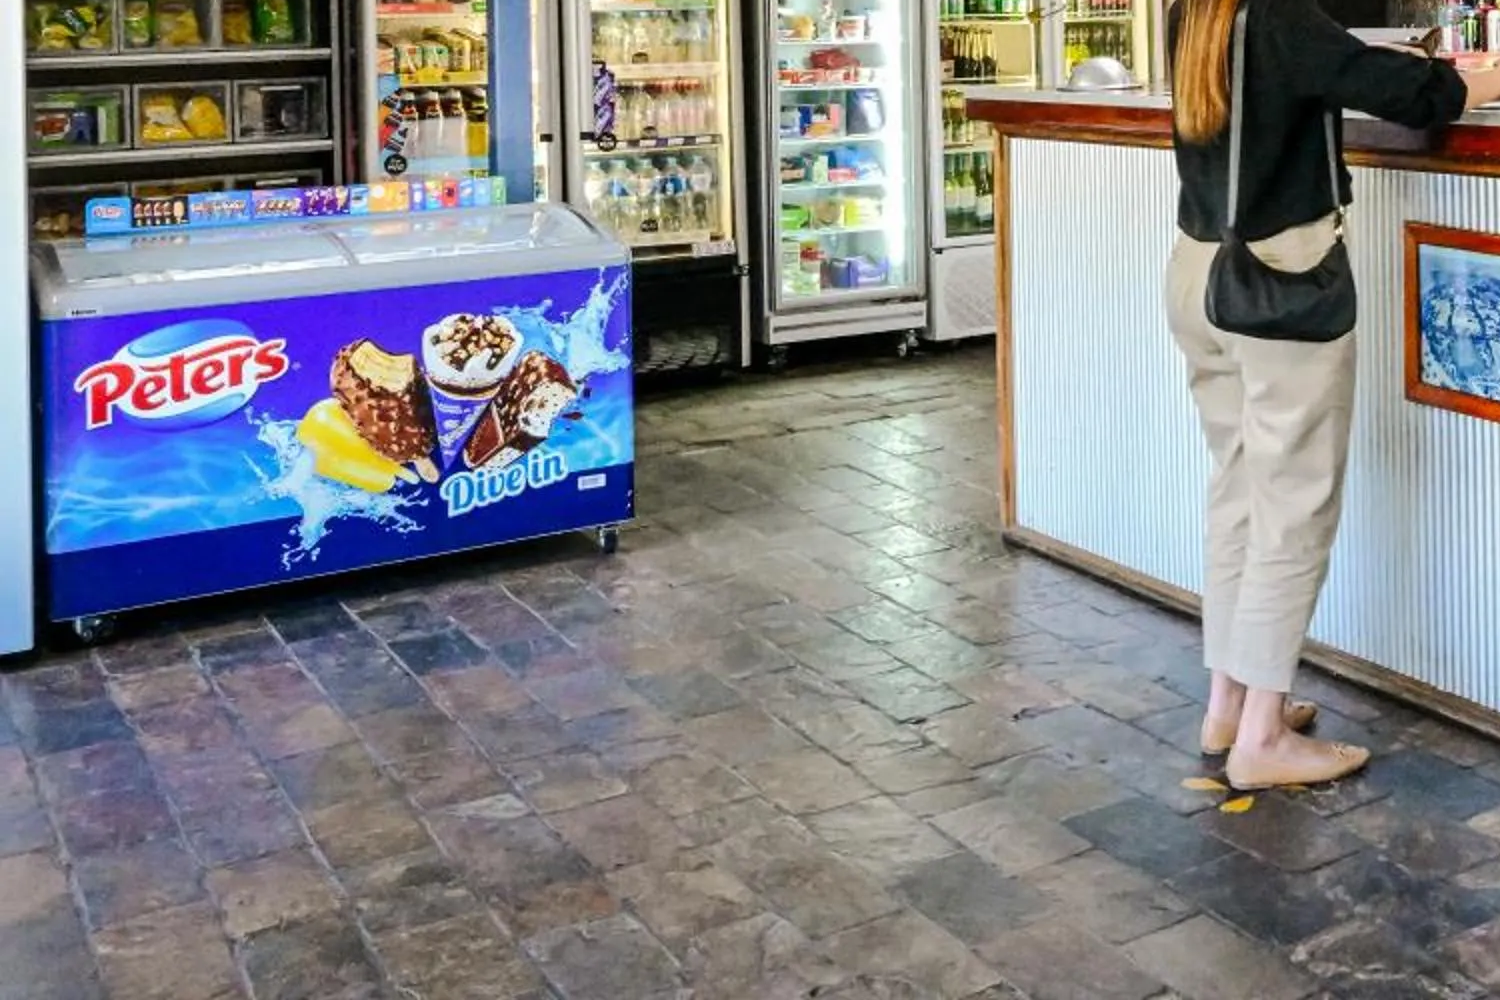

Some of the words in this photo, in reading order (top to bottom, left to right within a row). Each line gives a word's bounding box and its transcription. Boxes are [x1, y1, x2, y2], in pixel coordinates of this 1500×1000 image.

[75, 337, 289, 428] Peters
[440, 464, 527, 517] Dive
[527, 448, 568, 488] in
